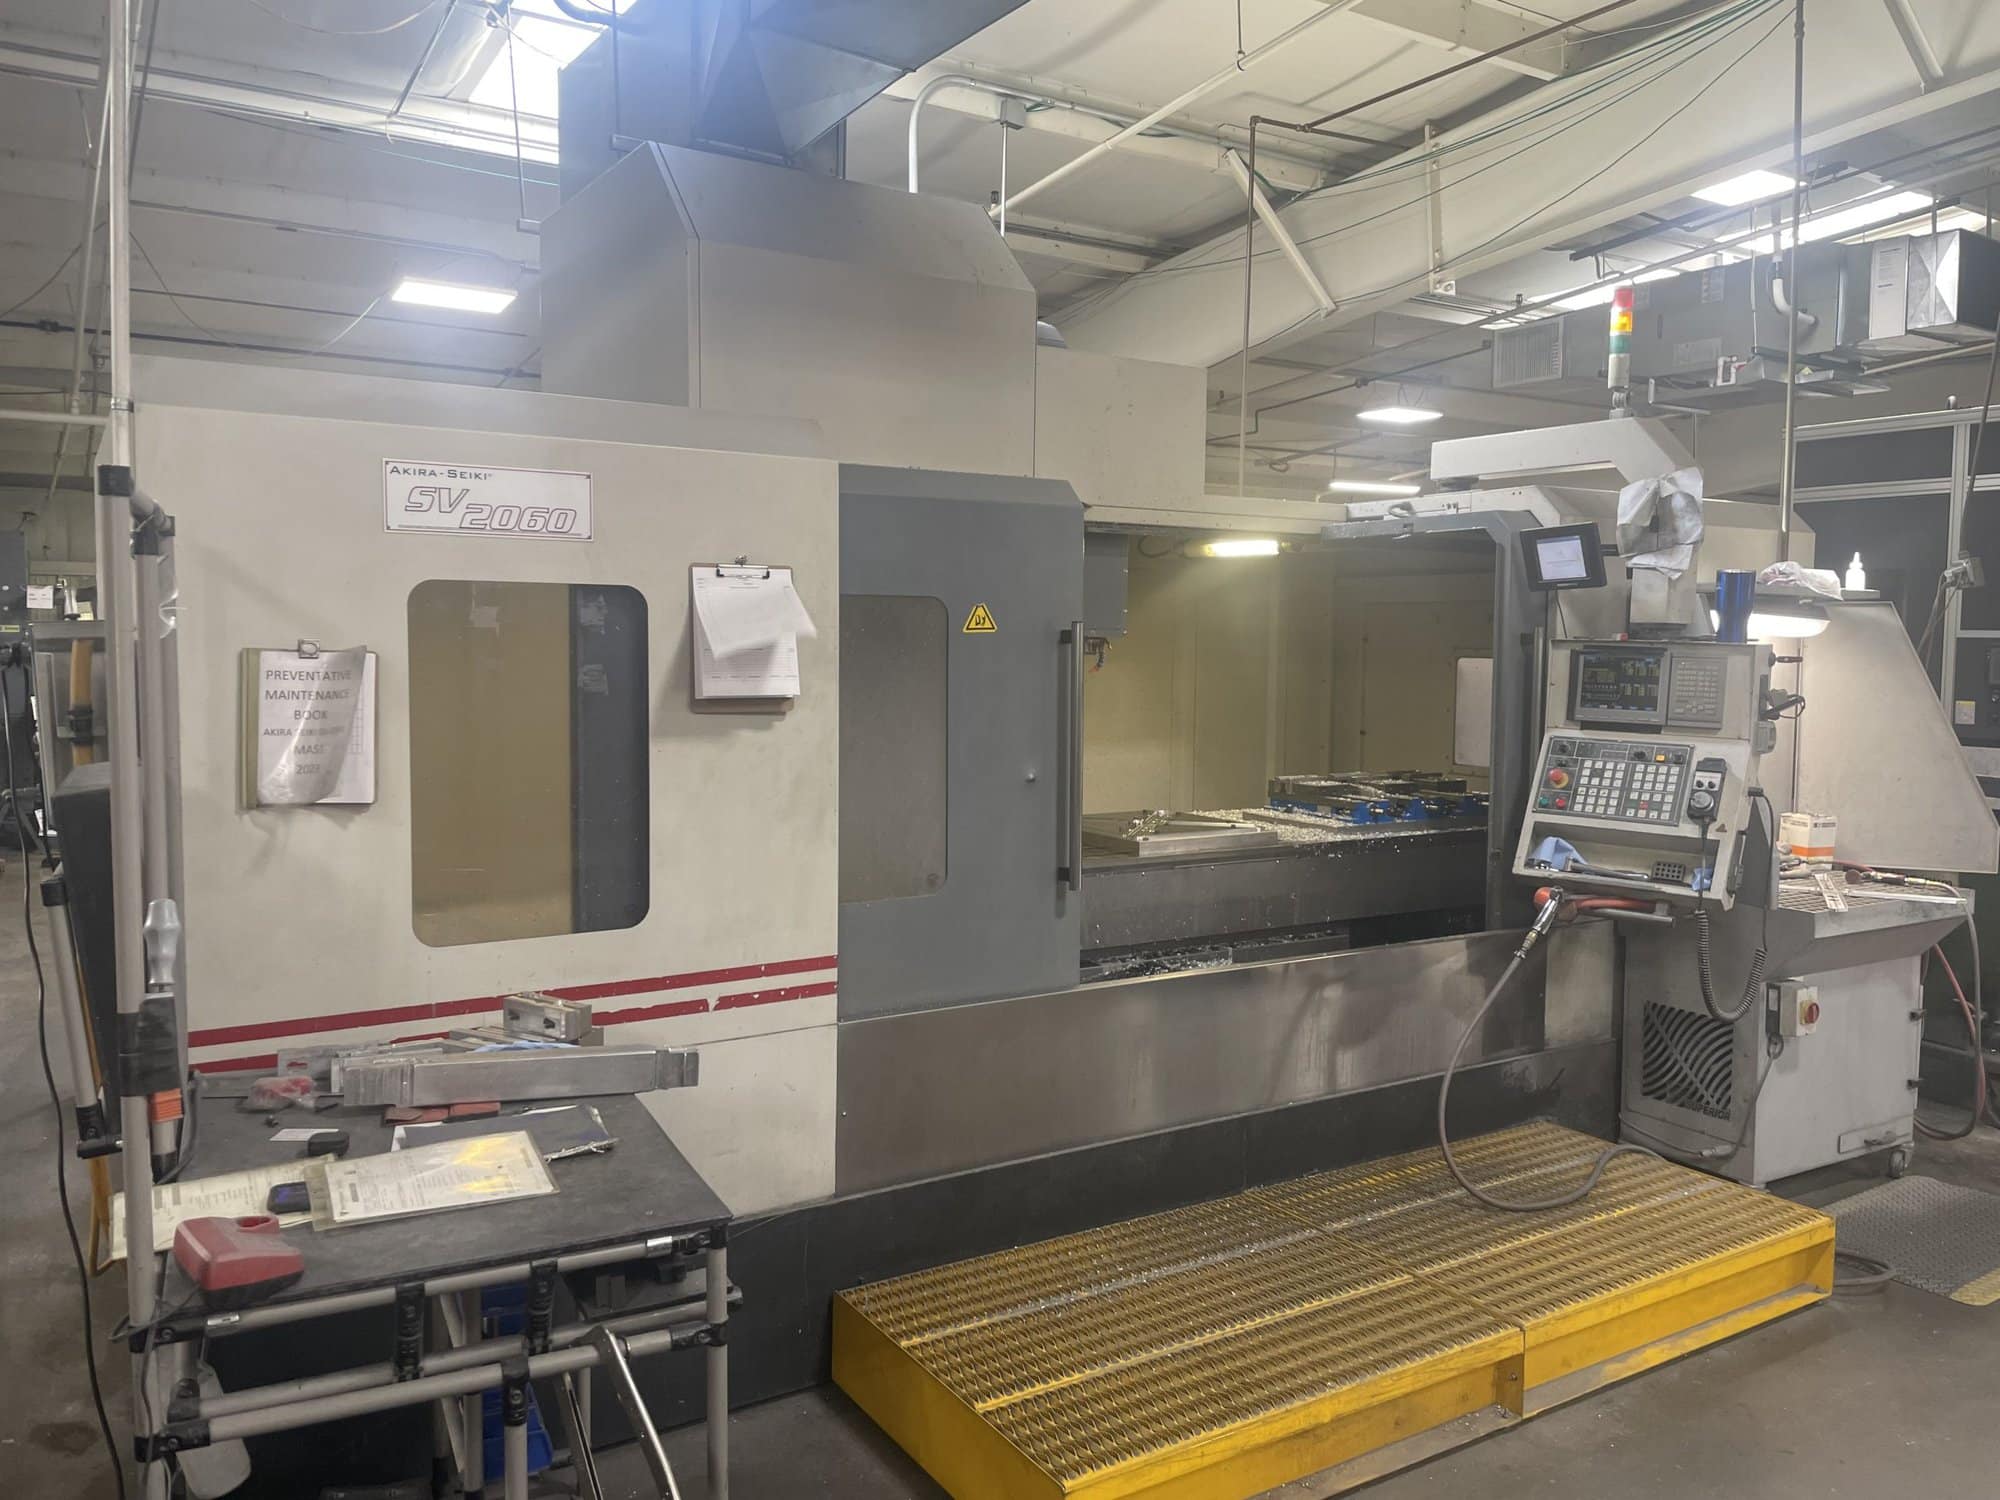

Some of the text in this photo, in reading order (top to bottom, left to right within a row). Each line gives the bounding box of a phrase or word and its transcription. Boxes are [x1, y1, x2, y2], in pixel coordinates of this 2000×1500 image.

[265, 670, 352, 681] PREVENTATIVE
[264, 689, 351, 701] MAINTENANCE
[294, 710, 328, 720] BOOK
[263, 728, 292, 737] AKIRA
